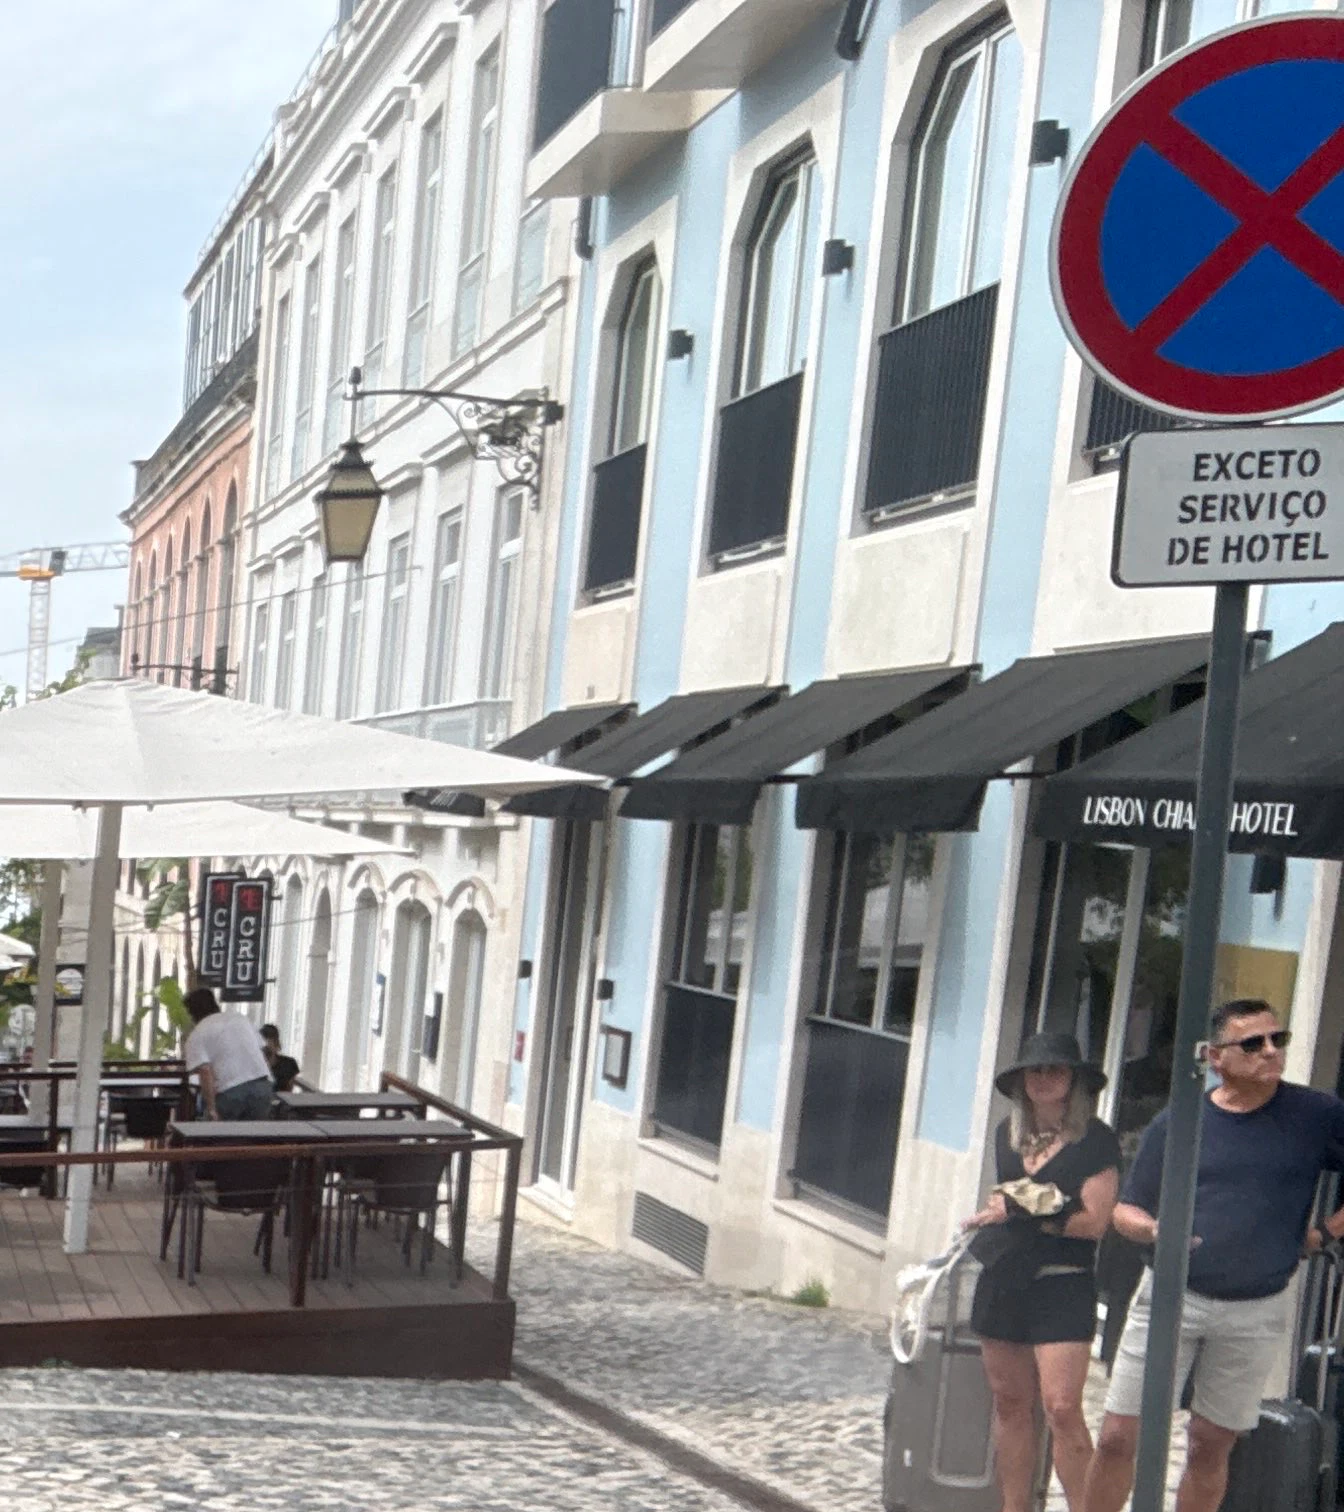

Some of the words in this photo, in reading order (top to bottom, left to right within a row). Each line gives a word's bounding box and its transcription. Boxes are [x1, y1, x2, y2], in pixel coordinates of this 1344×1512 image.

[1193, 448, 1322, 482] EXCETO
[1177, 490, 1327, 527] SERVIÇO
[1166, 536, 1211, 566] DE
[1221, 531, 1330, 564] HOTEL
[1083, 796, 1148, 827] LISBON
[1152, 798, 1198, 831] CHIA
[1229, 801, 1299, 837] HOTEL
[211, 907, 228, 969] CRU
[236, 915, 257, 982] CRU
